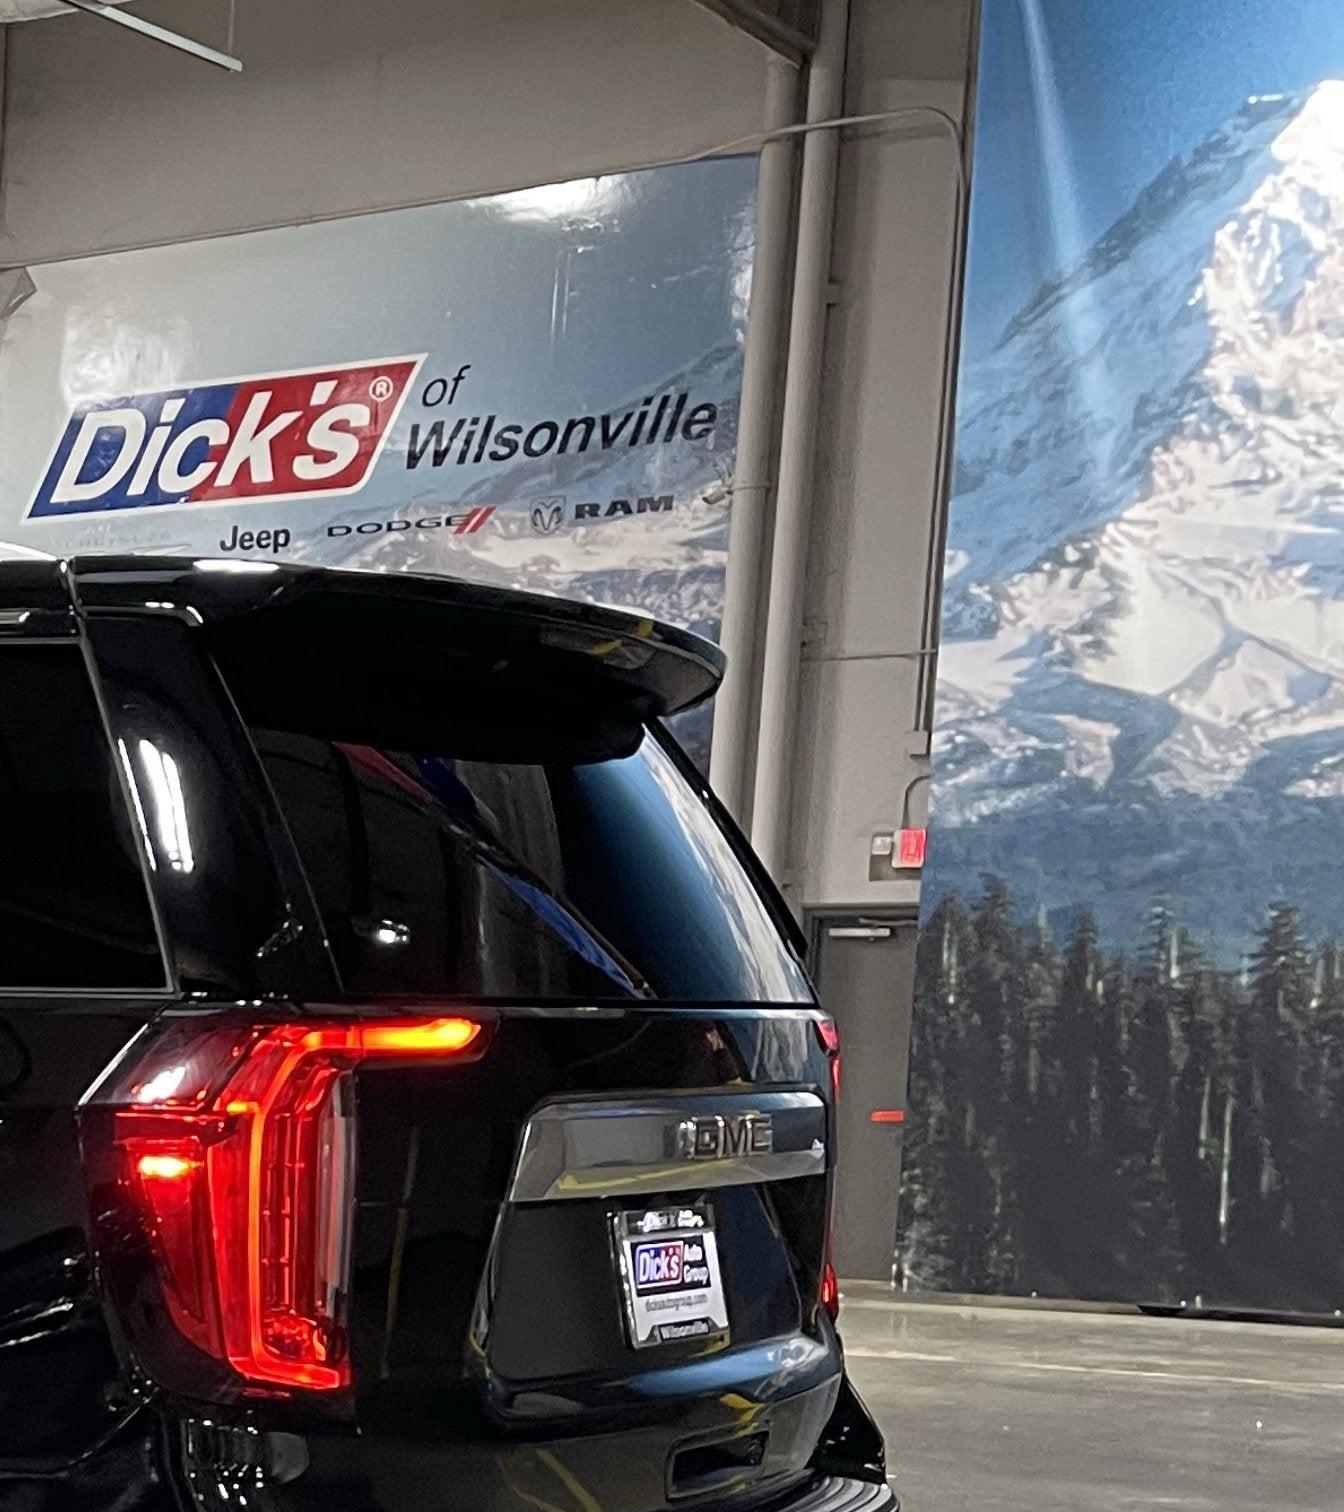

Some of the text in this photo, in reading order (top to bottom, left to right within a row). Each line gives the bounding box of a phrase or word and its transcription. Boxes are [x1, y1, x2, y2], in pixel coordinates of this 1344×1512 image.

[421, 365, 471, 408] of
[406, 392, 717, 470] Wilsonville
[575, 495, 674, 519] RAM
[220, 525, 291, 553] Jeep
[327, 514, 470, 537] DODGE
[639, 1246, 680, 1283] Dick's
